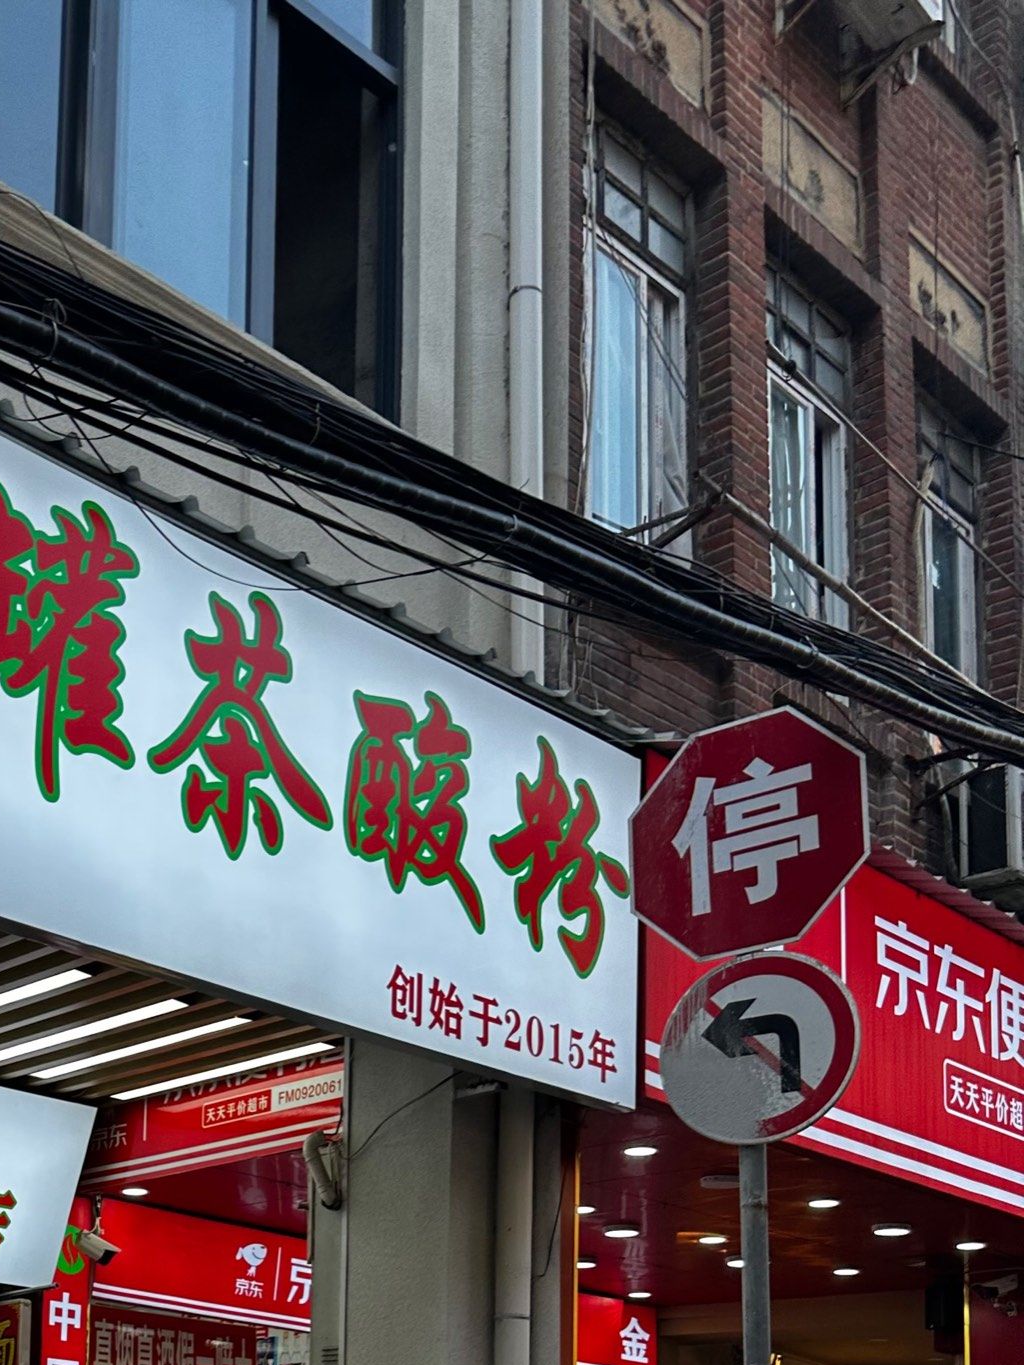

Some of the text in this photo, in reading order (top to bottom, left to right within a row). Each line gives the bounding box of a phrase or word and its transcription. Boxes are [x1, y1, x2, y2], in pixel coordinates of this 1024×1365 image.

[672, 757, 821, 917] 停
[387, 964, 618, 1083] 创始于2015年
[205, 1094, 269, 1123] 天天平价超市
[234, 1278, 264, 1299] 京东
